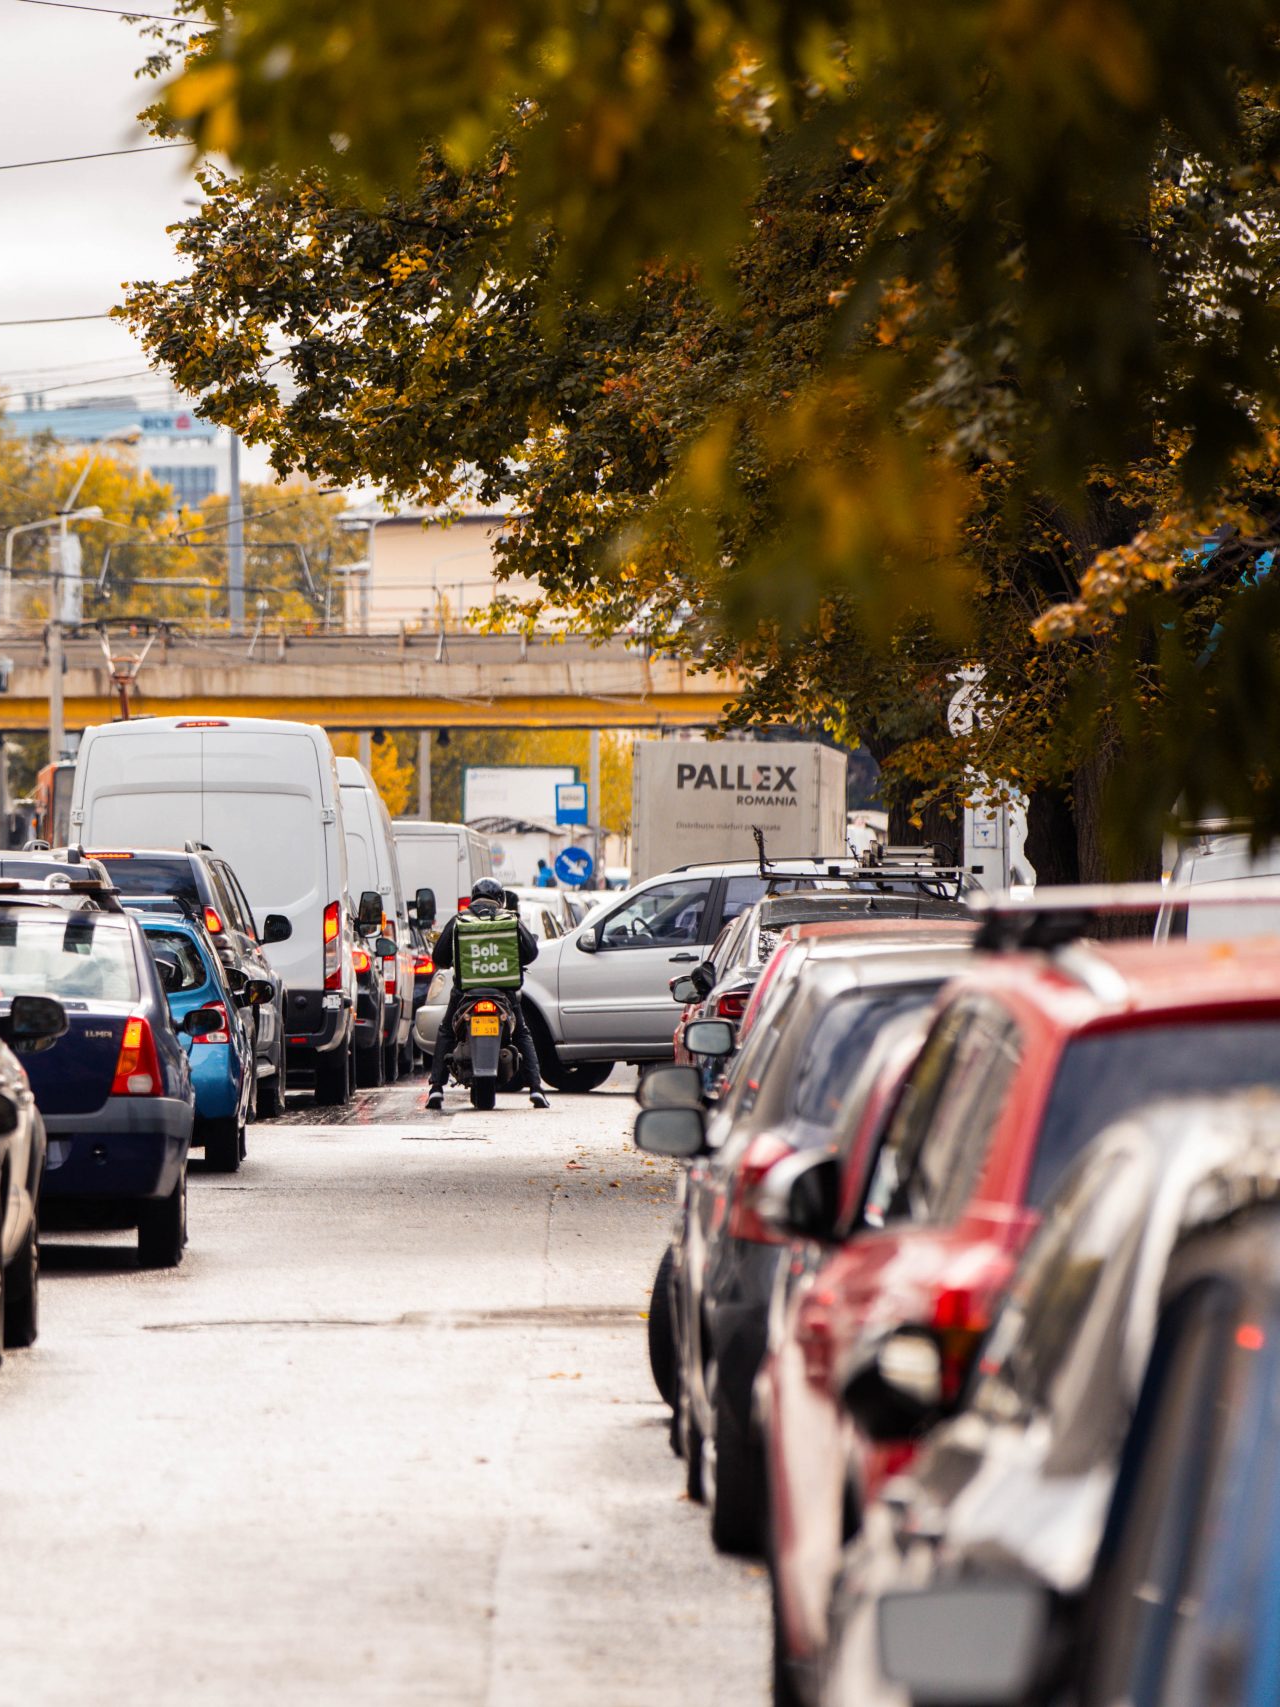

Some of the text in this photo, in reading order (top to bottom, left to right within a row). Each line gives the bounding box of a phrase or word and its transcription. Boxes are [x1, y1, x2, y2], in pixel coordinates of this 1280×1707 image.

[676, 763, 797, 792] PALLEX
[736, 795, 797, 807] ROMANIA
[470, 943, 499, 960] Bolt
[472, 958, 508, 974] Food
